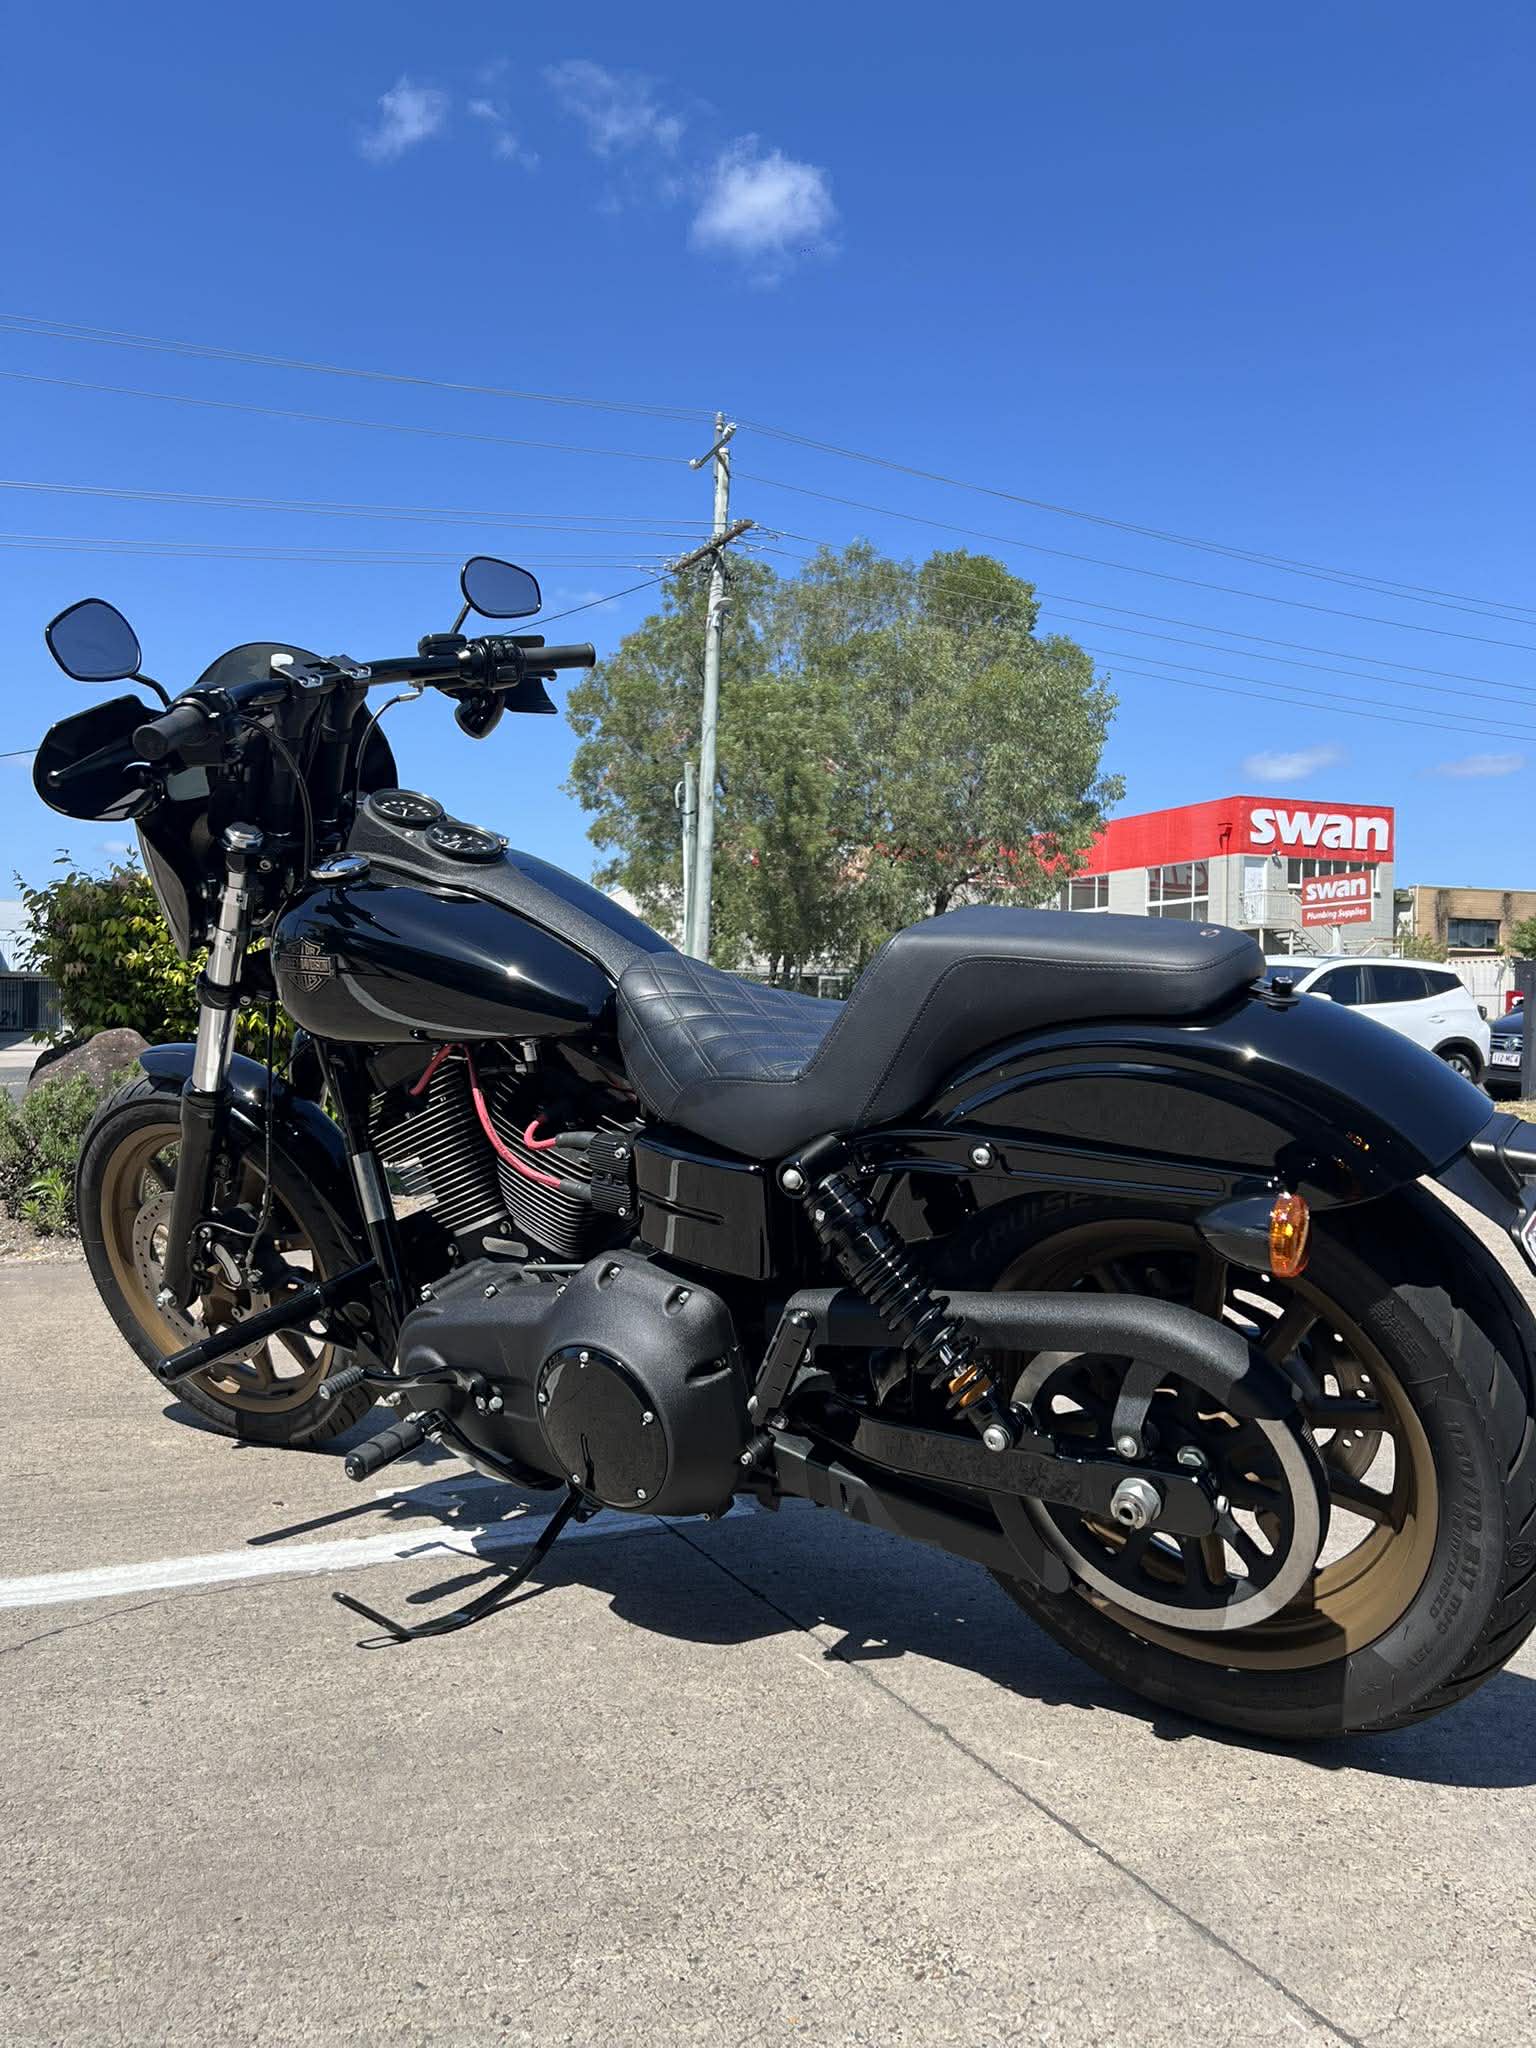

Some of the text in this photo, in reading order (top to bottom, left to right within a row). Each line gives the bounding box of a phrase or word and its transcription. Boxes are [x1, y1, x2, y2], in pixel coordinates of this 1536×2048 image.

[1250, 808, 1389, 851] swan
[1306, 878, 1367, 901] swan
[1307, 907, 1367, 921] Plumbing Supplies
